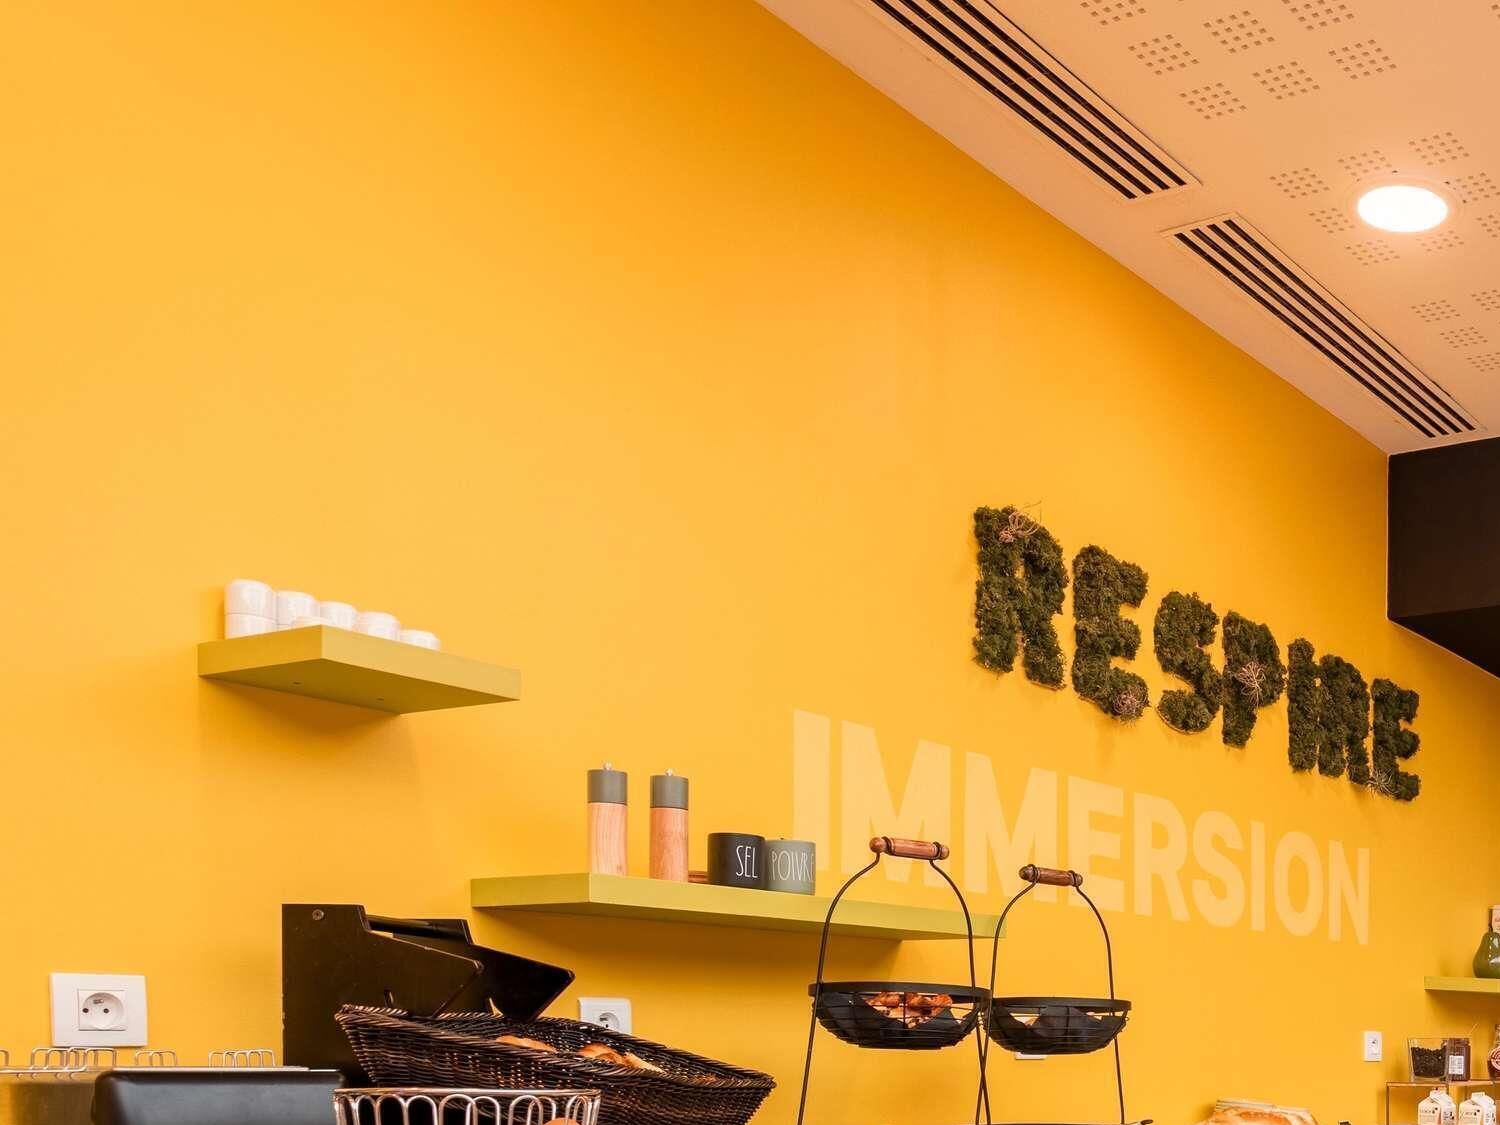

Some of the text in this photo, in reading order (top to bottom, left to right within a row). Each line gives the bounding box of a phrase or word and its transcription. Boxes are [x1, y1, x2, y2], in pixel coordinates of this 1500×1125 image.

[974, 505, 1420, 801] RESPIRE
[735, 845, 759, 878] SEL
[793, 710, 1370, 946] IMMERSION
